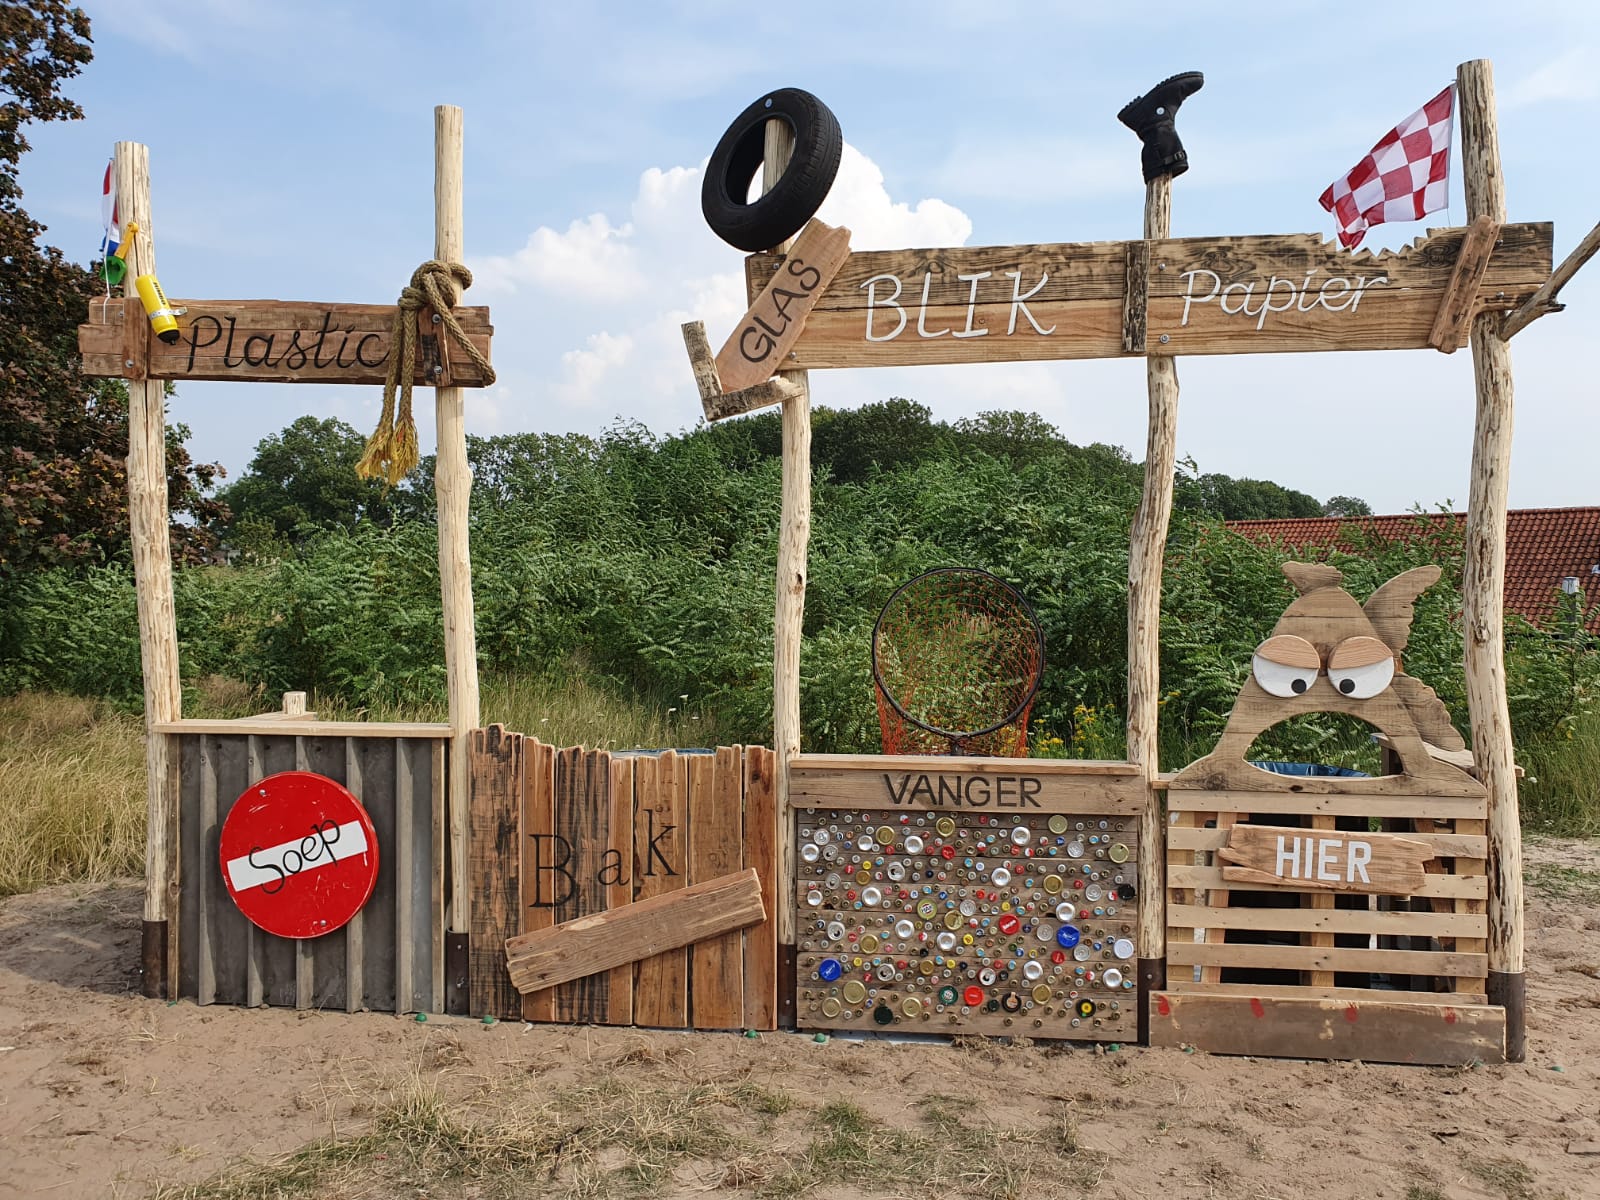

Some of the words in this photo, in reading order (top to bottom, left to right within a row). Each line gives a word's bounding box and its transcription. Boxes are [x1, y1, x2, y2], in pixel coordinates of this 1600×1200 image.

[739, 257, 821, 364] GLAS
[860, 271, 1057, 342] BLIK
[1179, 268, 1388, 331] Papier
[183, 311, 391, 373] Plastic
[883, 773, 1042, 808] VANGER
[249, 819, 340, 895] Soep
[1275, 835, 1372, 884] HIER
